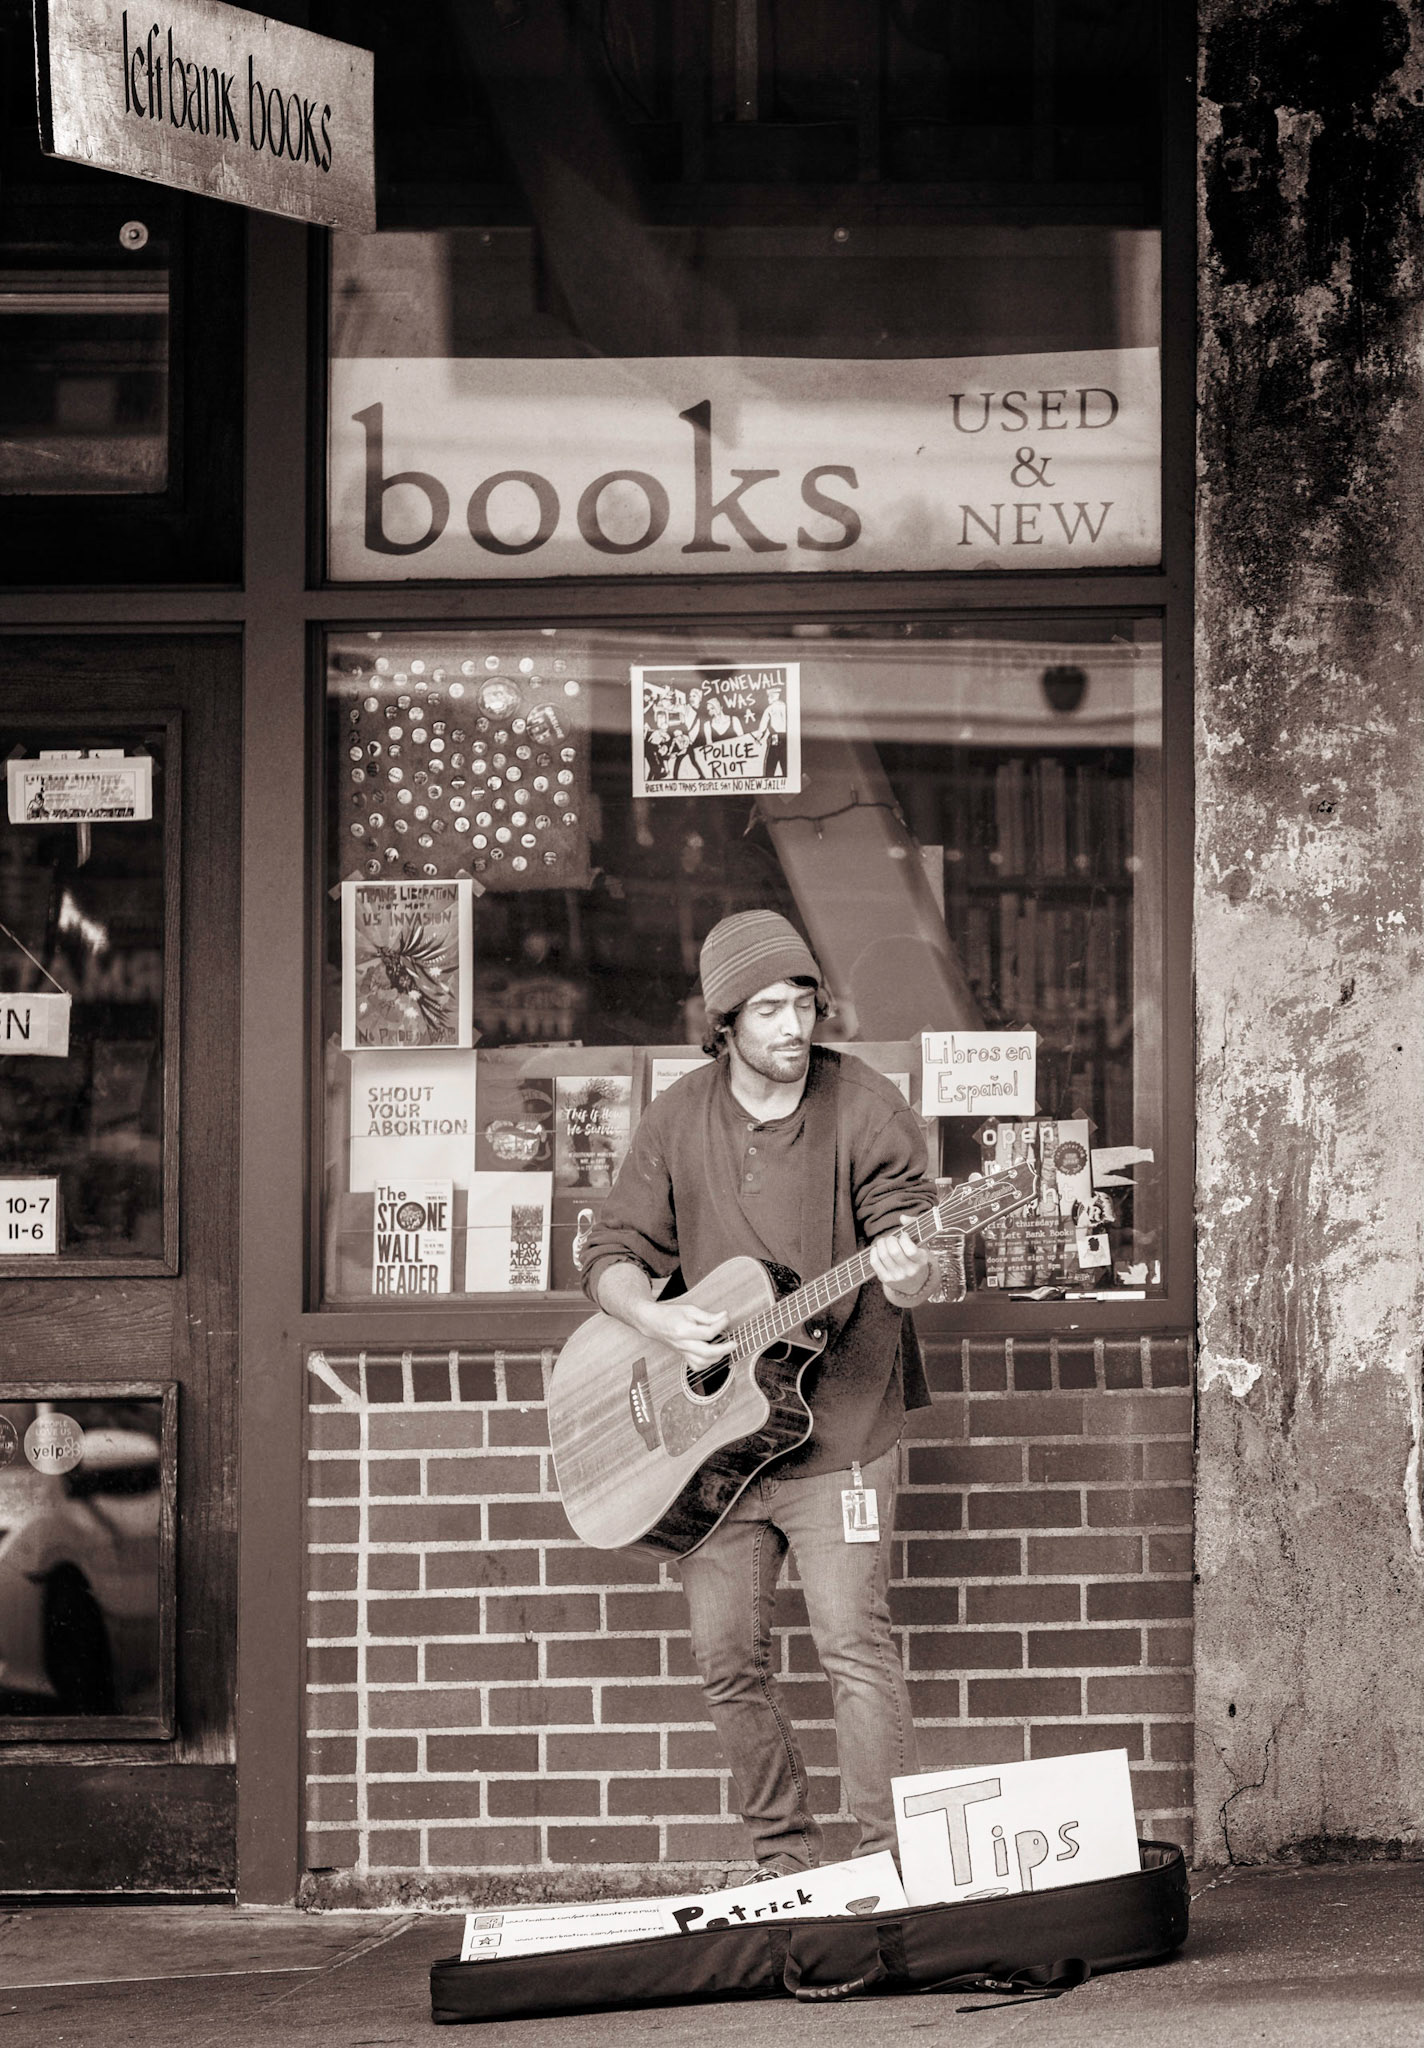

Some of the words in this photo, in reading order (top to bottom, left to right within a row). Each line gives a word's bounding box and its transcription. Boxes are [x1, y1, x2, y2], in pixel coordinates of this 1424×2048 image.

[249, 55, 331, 172] books
[949, 388, 1119, 433] USED
[1010, 446, 1055, 488] &
[352, 402, 861, 556] books
[957, 502, 1114, 545] NEW
[702, 670, 784, 696] STONEWALL
[723, 693, 756, 709] WAS
[744, 709, 756, 723] A
[700, 743, 759, 760] POLICE
[708, 761, 747, 777] RIOT
[678, 782, 697, 793] TRANS
[698, 782, 719, 791] PEOPLE
[733, 779, 744, 791] NO
[745, 779, 762, 790] NEW
[400, 885, 457, 901] LIBERATION
[363, 913, 382, 926] US
[390, 911, 451, 926] INVASION
[924, 1035, 1001, 1064] Libros
[1005, 1044, 1032, 1061] en
[368, 1087, 434, 1102] SHOUT
[937, 1070, 1018, 1112] Español
[368, 1104, 420, 1119] YOUR
[566, 1108, 588, 1123] This
[367, 1119, 468, 1136] ABORTION
[567, 1124, 582, 1136] We
[982, 1126, 1054, 1150] open
[377, 1186, 407, 1201] The
[6, 1197, 50, 1214] 10-7
[377, 1202, 448, 1232] STONE
[1015, 1218, 1059, 1229] thursdays
[1002, 1231, 1022, 1240] Left
[1025, 1230, 1046, 1238] Bank
[377, 1234, 423, 1264] WALL
[516, 1241, 537, 1250] TOO
[510, 1250, 541, 1259] HEAVY
[518, 1258, 541, 1266] LOAD
[1027, 1254, 1044, 1263] sign
[376, 1265, 439, 1295] READER
[33, 1444, 64, 1460] yelp
[903, 1777, 1080, 1892] Tips
[672, 1888, 813, 1933] Patrick
